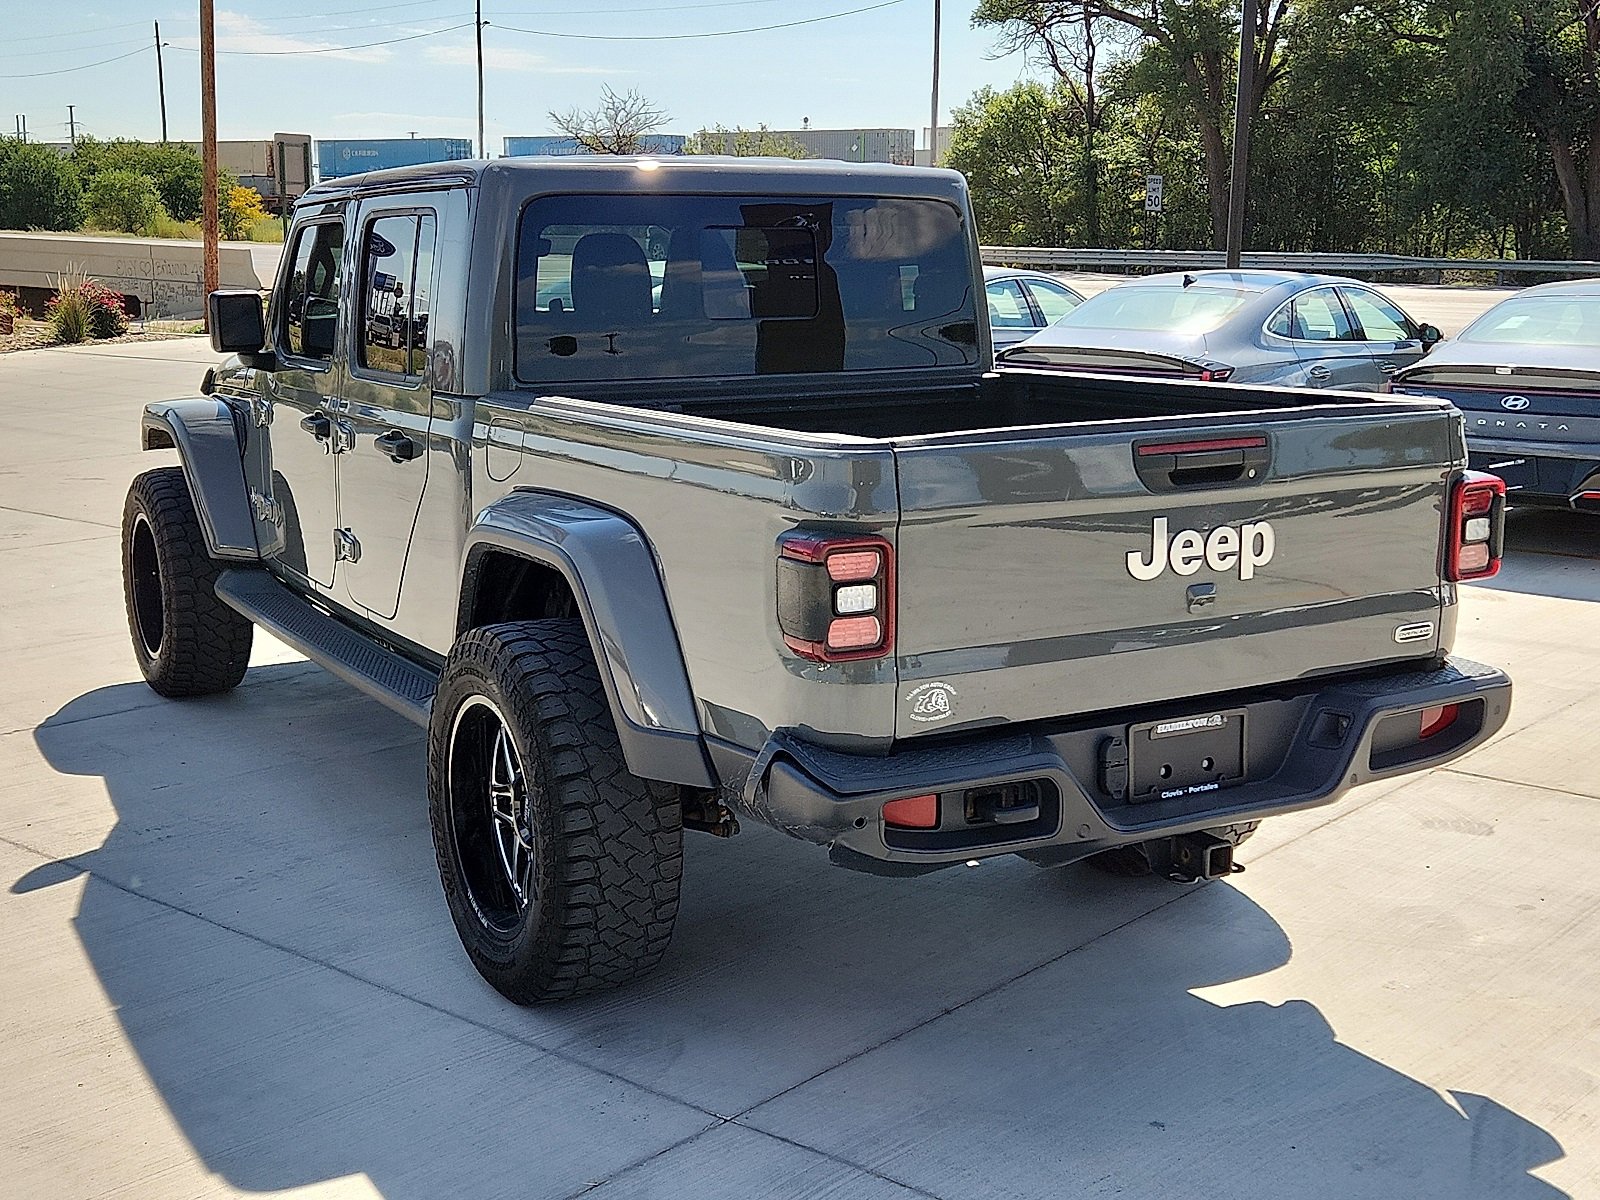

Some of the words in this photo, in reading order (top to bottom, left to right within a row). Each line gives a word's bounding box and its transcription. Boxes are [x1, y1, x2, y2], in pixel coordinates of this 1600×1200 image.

[1147, 195, 1160, 207] 50
[1126, 516, 1276, 581] Jeep
[1161, 789, 1183, 799] Clovis
[1188, 783, 1219, 794] Portales
